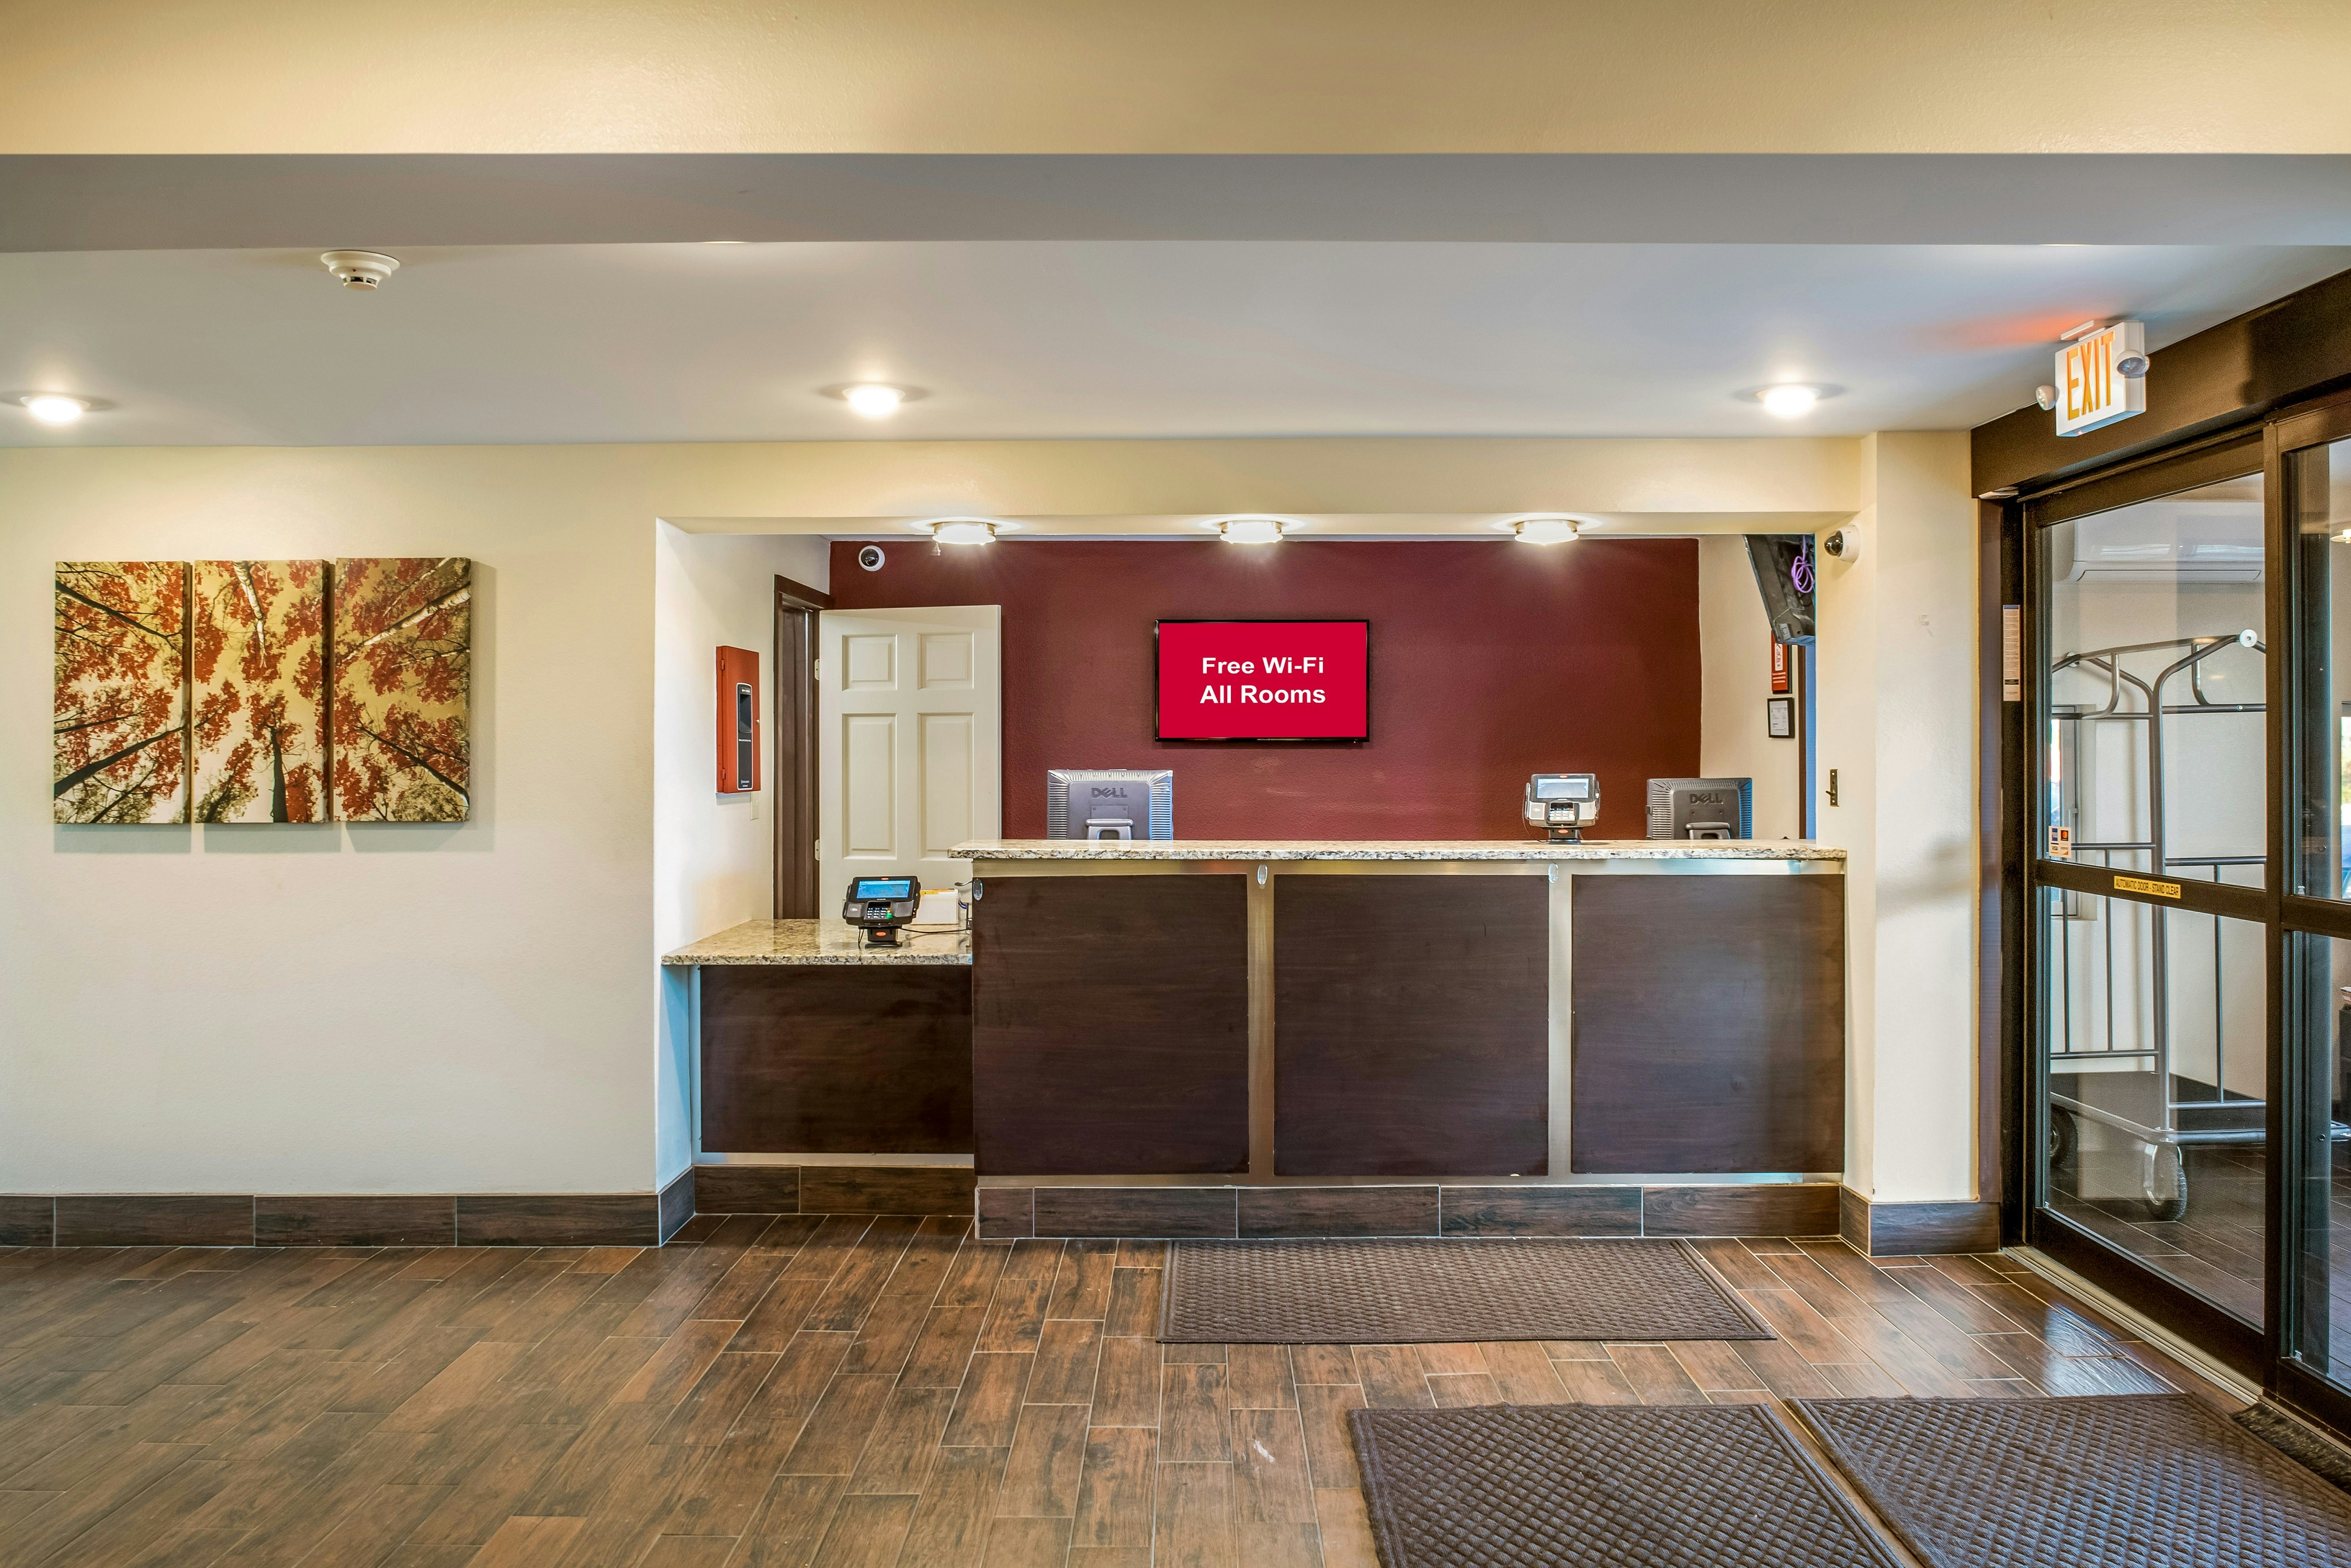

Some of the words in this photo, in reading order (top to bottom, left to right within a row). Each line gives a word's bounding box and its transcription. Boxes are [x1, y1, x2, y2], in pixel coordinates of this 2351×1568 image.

[2066, 331, 2115, 421] EXIT
[1202, 657, 1255, 674] Free
[1262, 657, 1324, 673] Wi-Fi
[1200, 685, 1231, 704] All
[1241, 685, 1326, 704] Rooms
[1091, 787, 1128, 799] DELL
[1689, 793, 1724, 805] DELL
[2115, 878, 2137, 889] AUTOMATIC
[2137, 881, 2149, 891] DOOR
[2152, 883, 2165, 894] STAND
[2166, 885, 2179, 897] CLEAR
